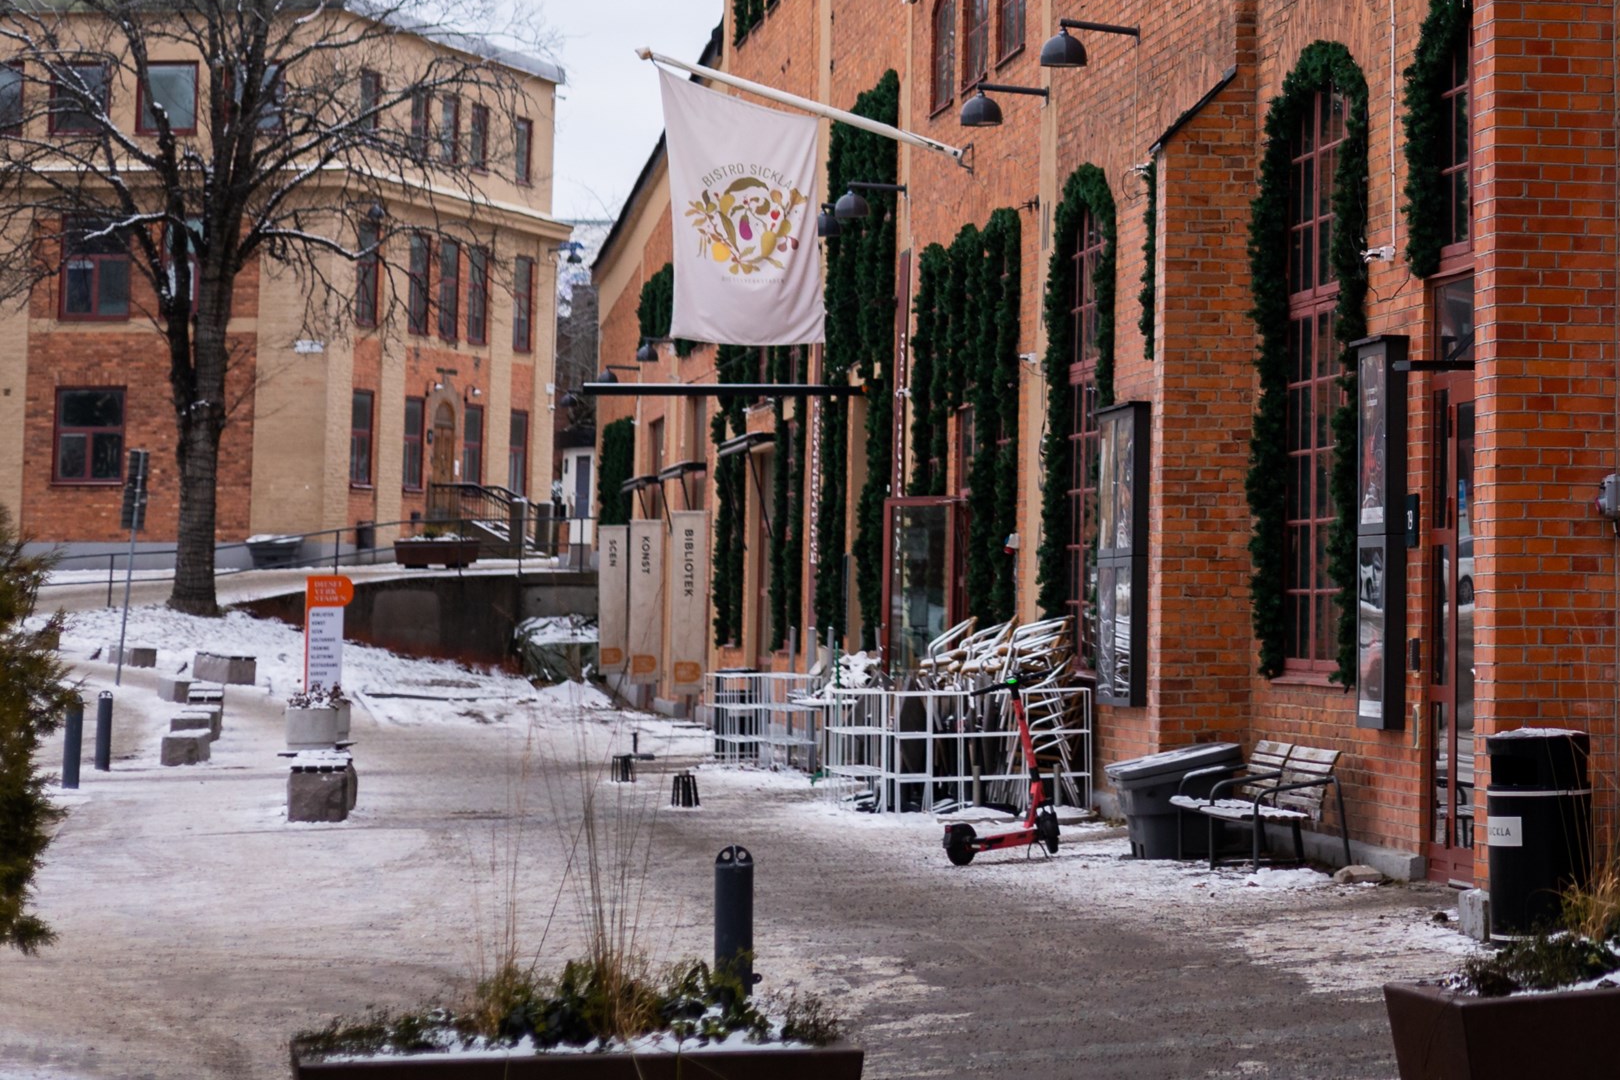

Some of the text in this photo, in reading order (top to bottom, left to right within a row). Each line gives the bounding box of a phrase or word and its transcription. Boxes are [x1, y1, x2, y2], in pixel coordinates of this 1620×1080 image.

[702, 163, 793, 190] BISTRO SICKLA
[1407, 510, 1414, 530] 19
[608, 539, 617, 568] SCEN
[641, 535, 650, 575] KONST
[684, 528, 694, 597] BIBLIOTEK
